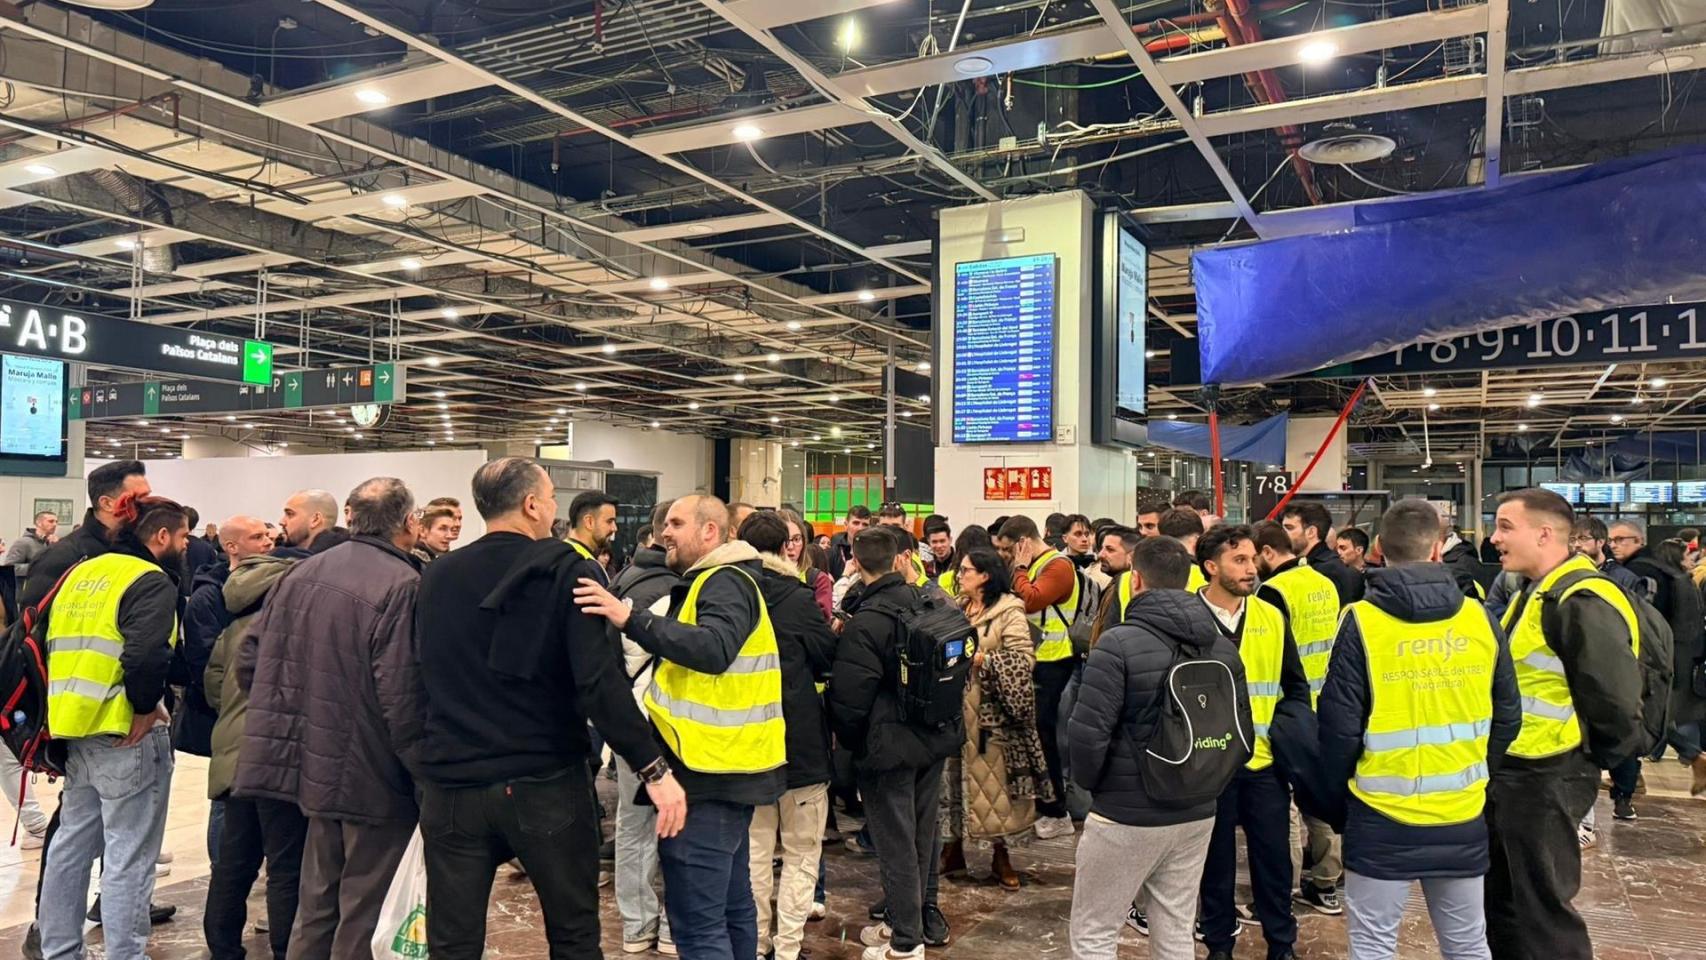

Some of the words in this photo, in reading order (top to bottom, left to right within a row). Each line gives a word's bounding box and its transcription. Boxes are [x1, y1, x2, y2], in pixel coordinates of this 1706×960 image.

[189, 335, 217, 350] Plaça
[218, 340, 239, 352] dels
[161, 344, 195, 359] Països
[196, 350, 239, 365] Catalans
[8, 368, 35, 378] Maruja
[36, 371, 57, 380] Mallo
[161, 384, 176, 392] Plaça
[176, 384, 187, 392] dels
[178, 393, 200, 401] Catalans
[1307, 585, 1331, 607] renfe
[1397, 628, 1468, 662] renfe
[1450, 665, 1466, 676] del
